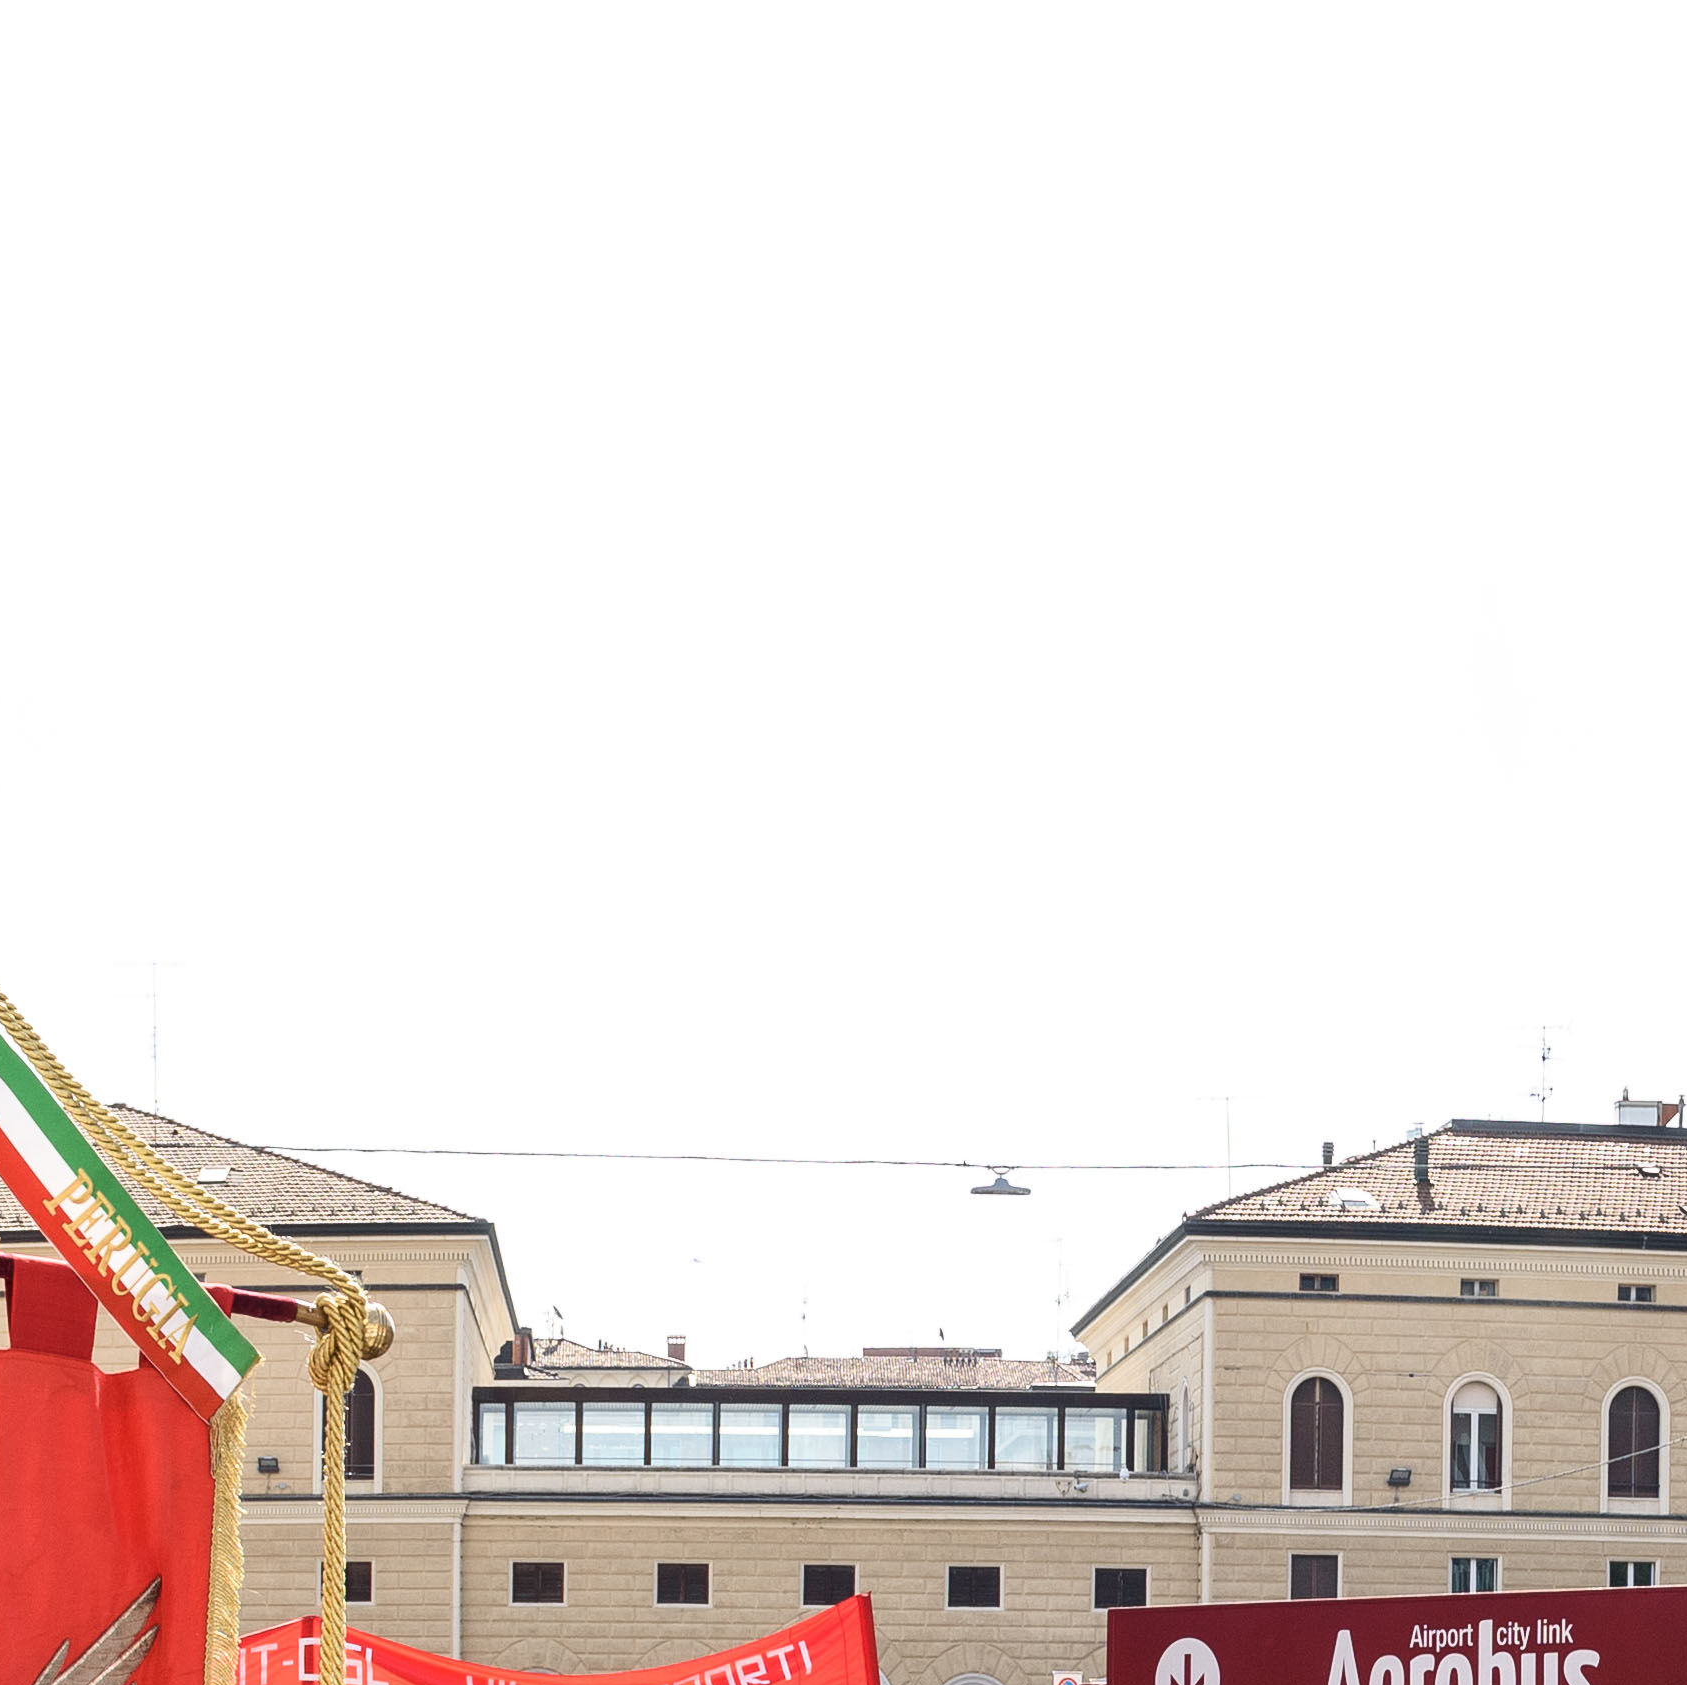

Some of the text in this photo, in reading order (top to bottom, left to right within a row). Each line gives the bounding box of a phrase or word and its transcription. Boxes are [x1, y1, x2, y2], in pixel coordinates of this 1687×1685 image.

[1410, 1619, 1573, 1652] Airport city link
